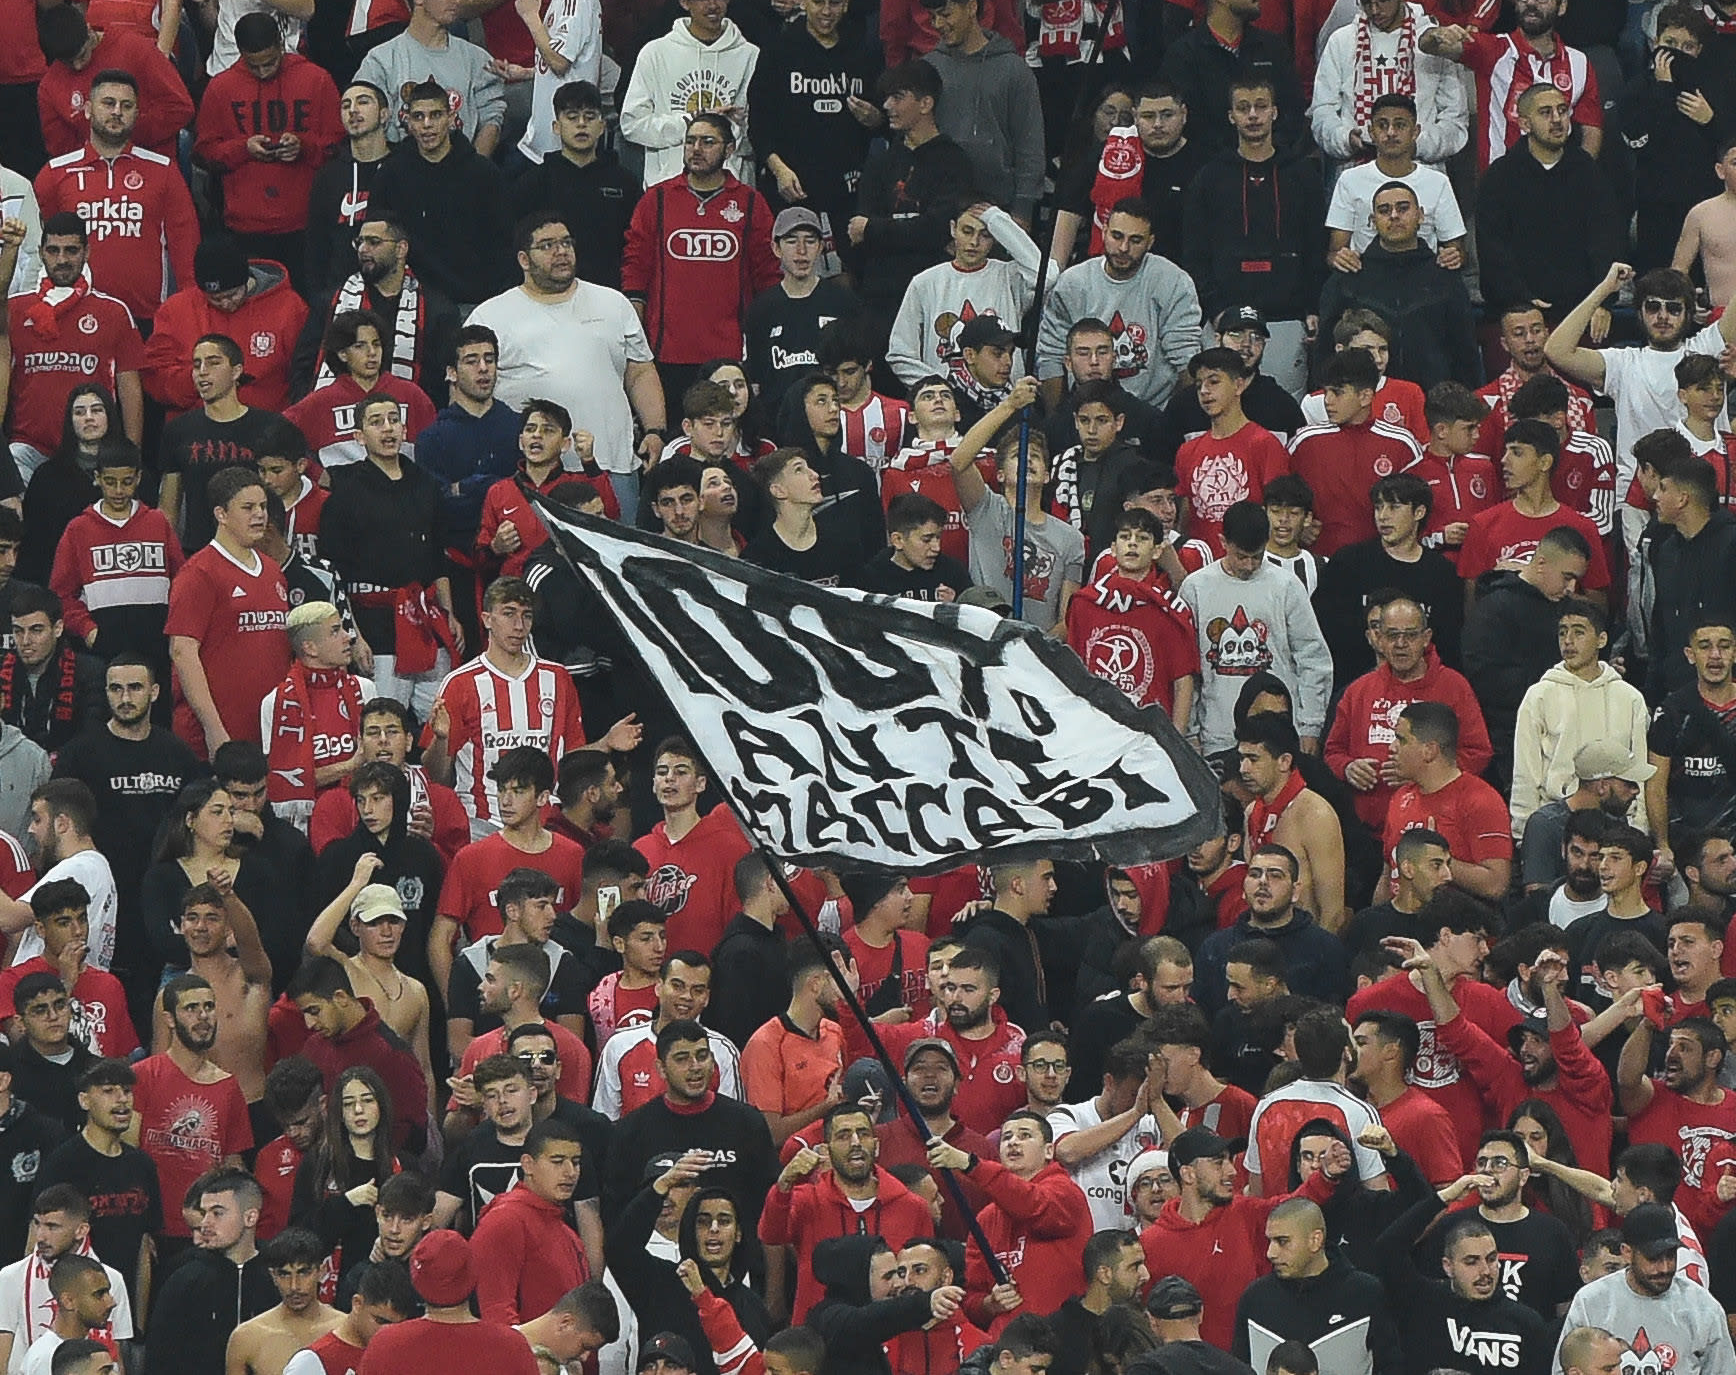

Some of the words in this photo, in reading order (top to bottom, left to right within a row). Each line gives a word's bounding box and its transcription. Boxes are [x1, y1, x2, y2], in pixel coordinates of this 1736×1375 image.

[76, 194, 144, 221] arkia
[25, 351, 80, 365] הכשרה
[238, 610, 288, 625] הכשרה
[730, 754, 1172, 855] MACCABI
[1446, 1317, 1522, 1368] VANS
